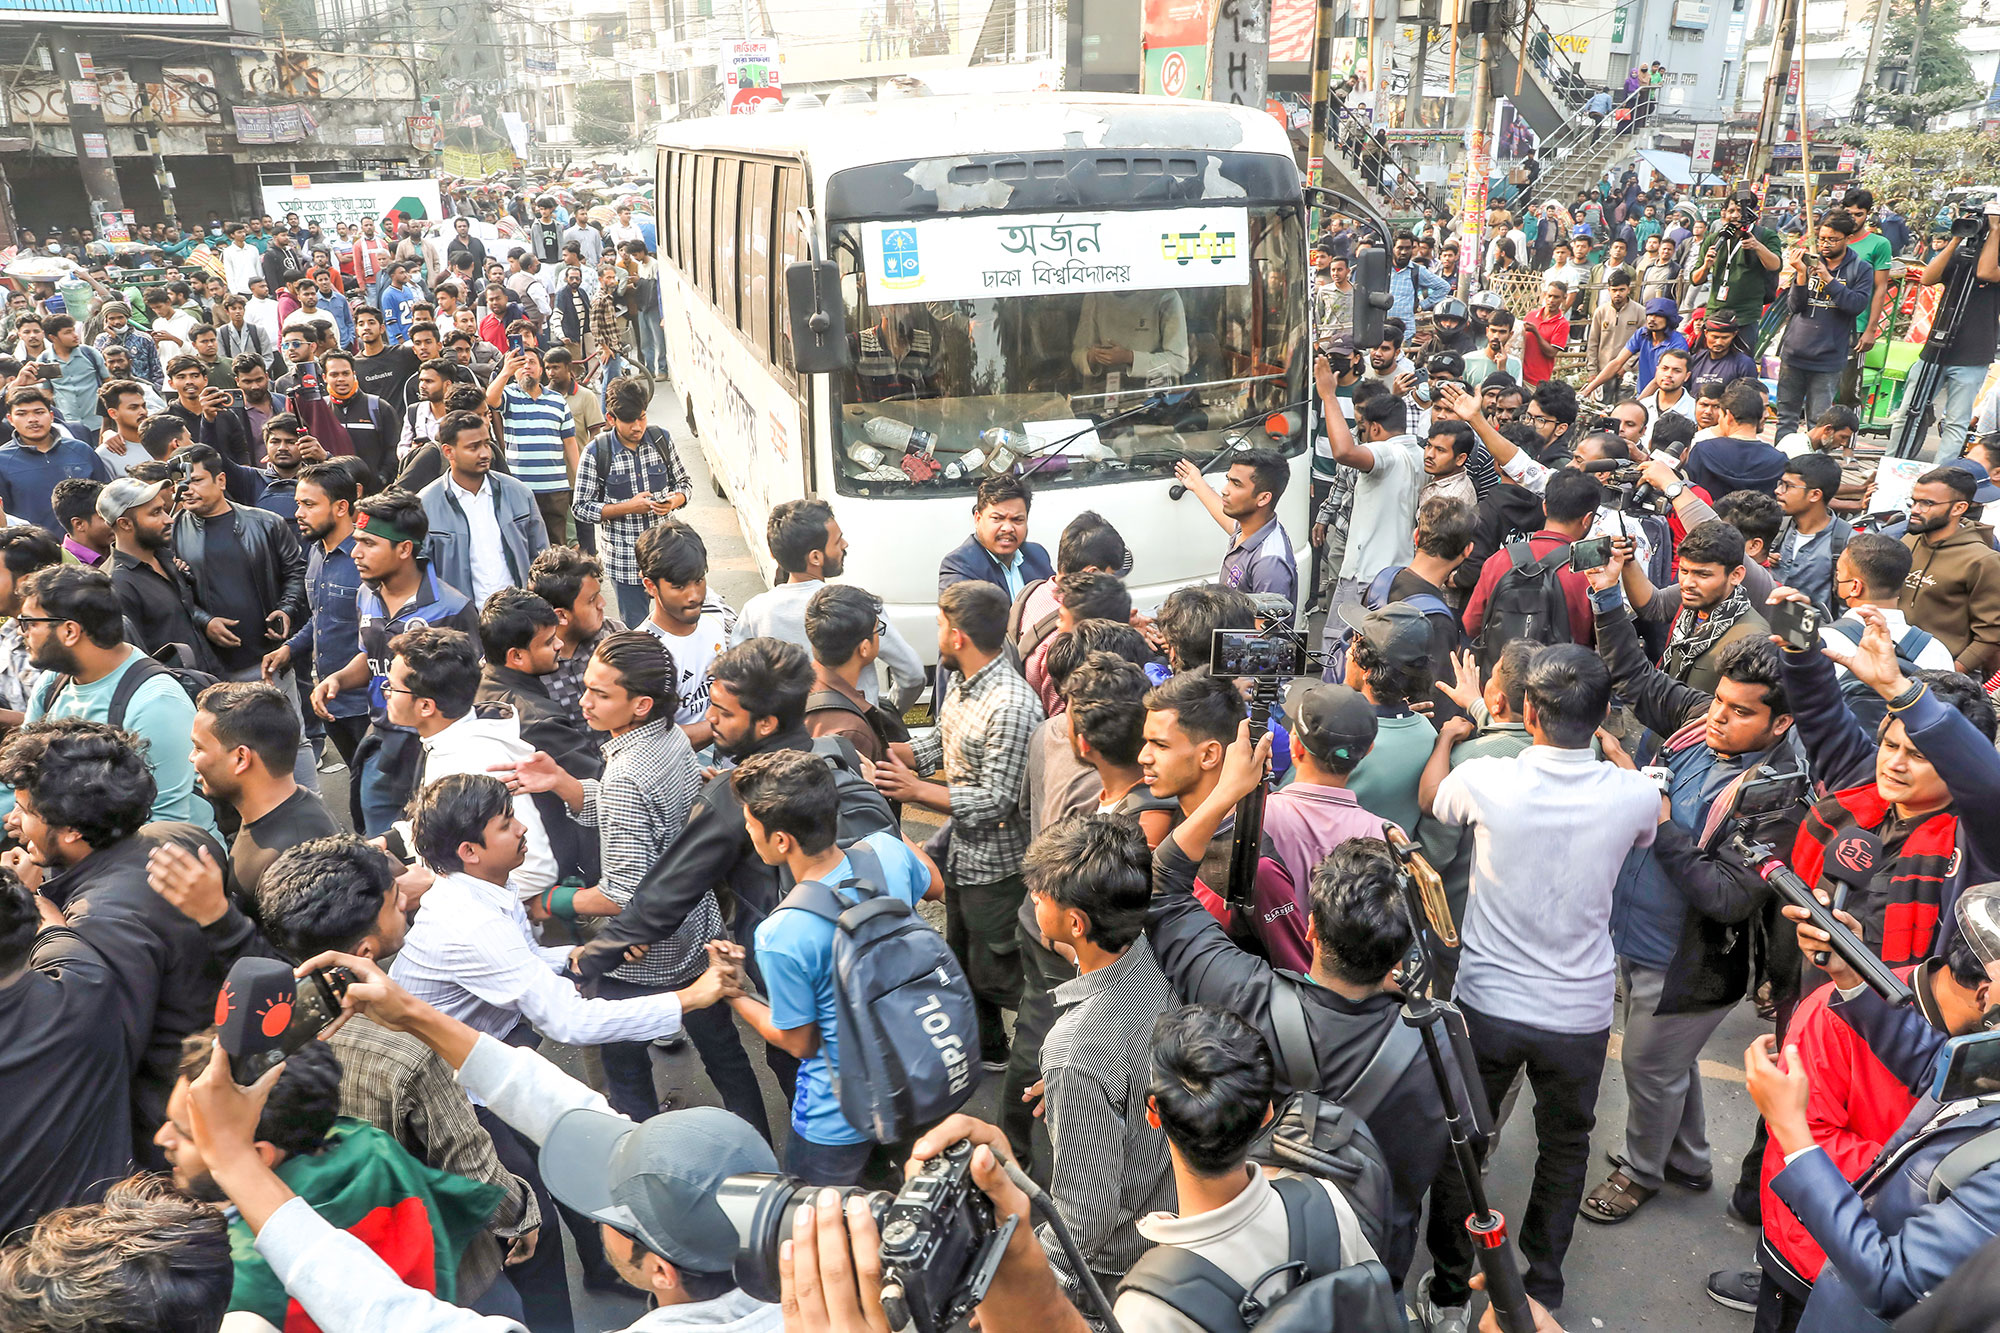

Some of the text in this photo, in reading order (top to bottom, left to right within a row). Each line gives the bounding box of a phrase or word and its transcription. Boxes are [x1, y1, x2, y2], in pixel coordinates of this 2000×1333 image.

[998, 214, 1101, 256] অর্জন
[982, 259, 1131, 288] ঢাকা বিশ্ববিদ্যালয়
[398, 300, 414, 325] 2
[681, 681, 713, 708] Emir
[690, 700, 705, 716] FLY
[914, 994, 970, 1097] REPSOL
